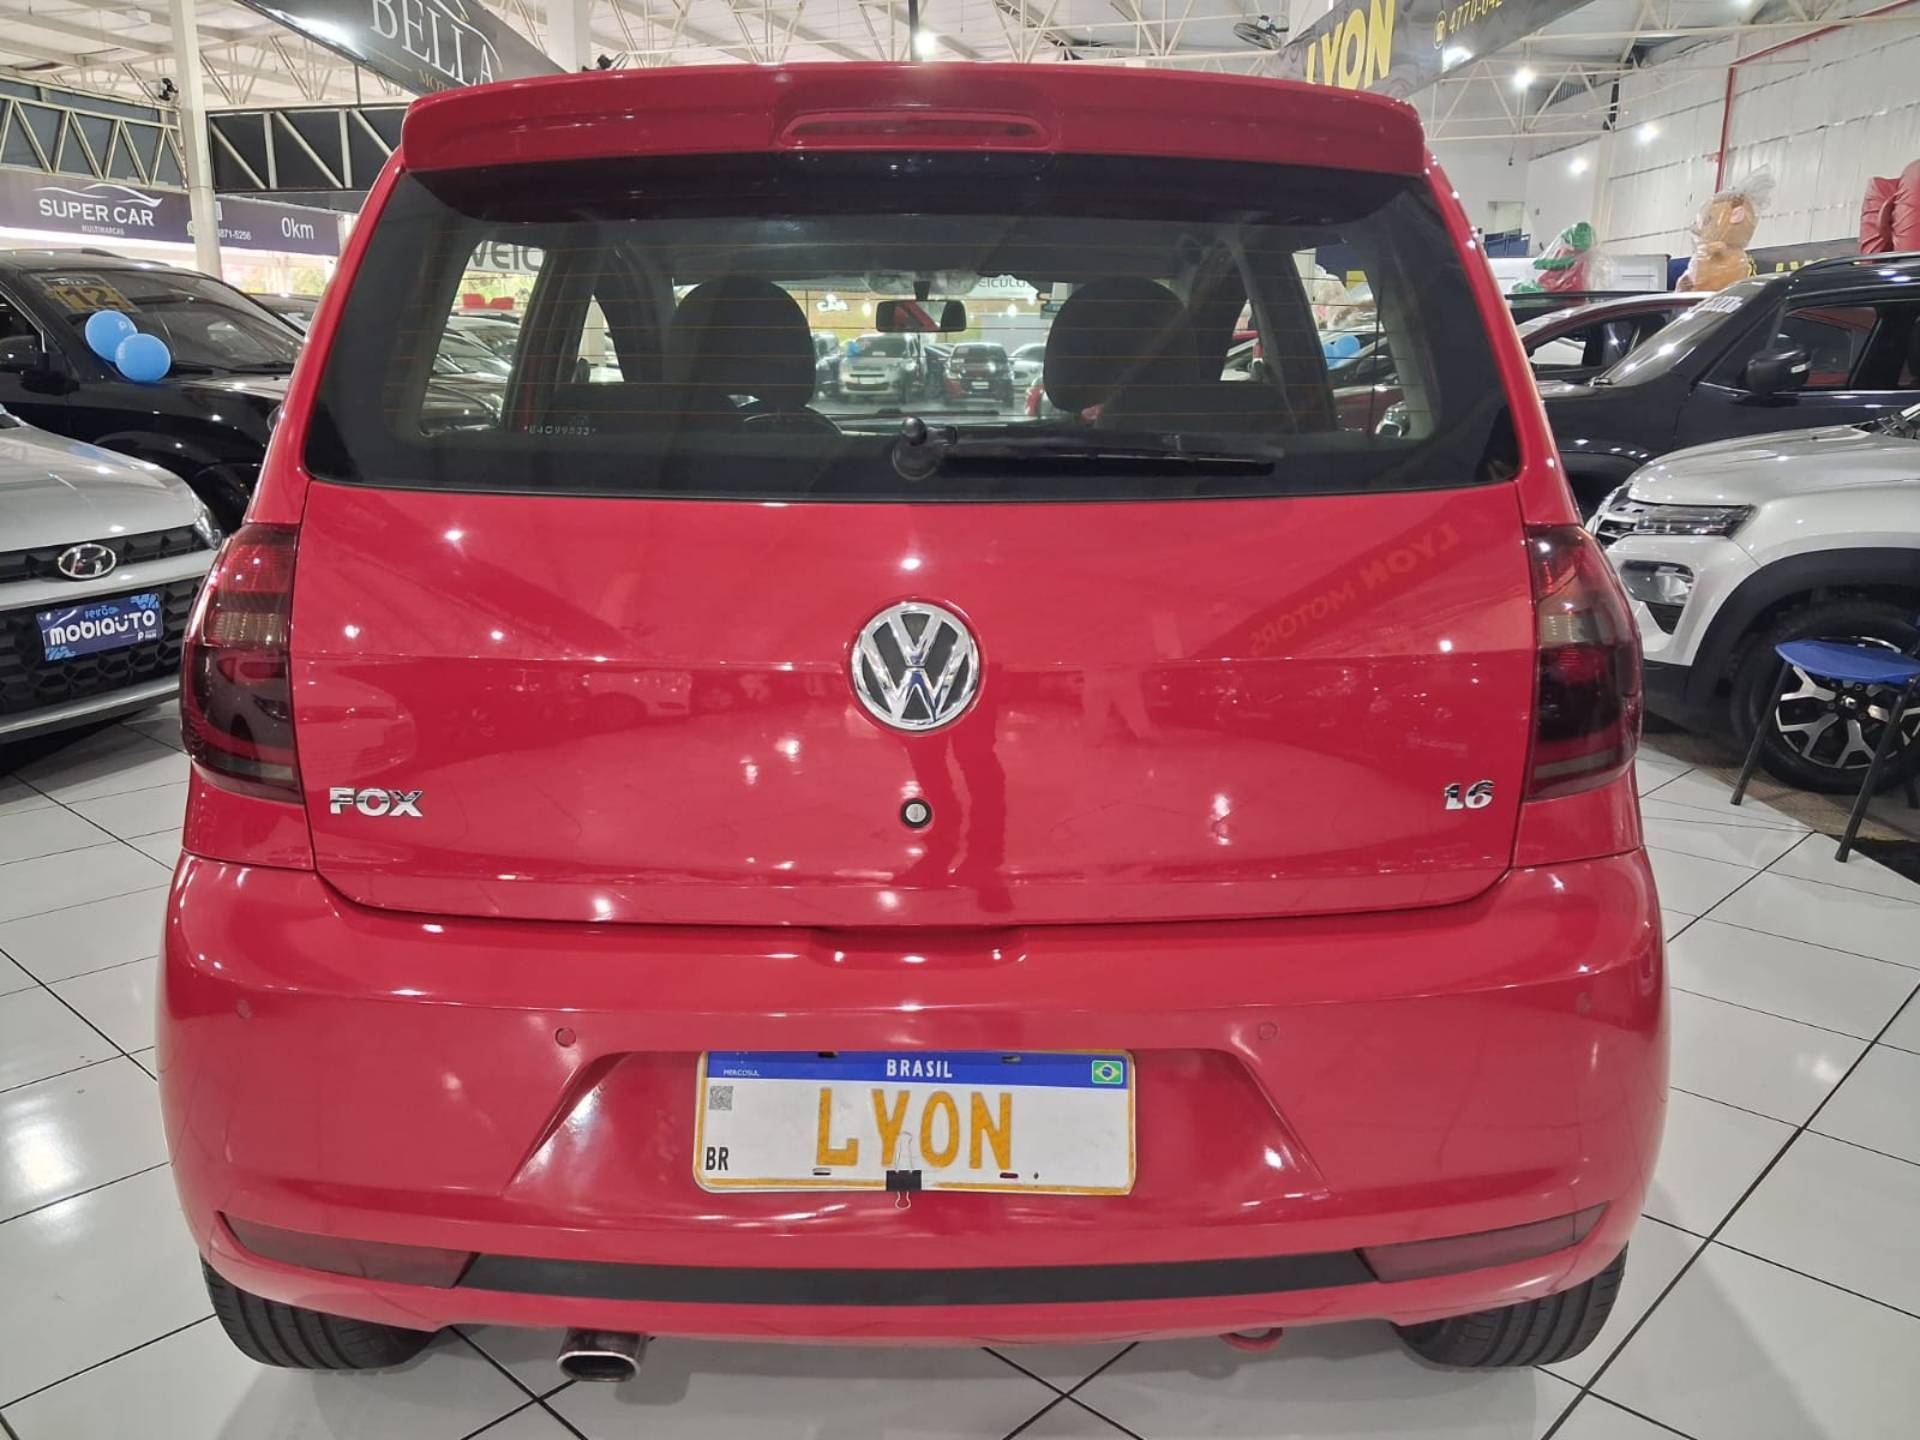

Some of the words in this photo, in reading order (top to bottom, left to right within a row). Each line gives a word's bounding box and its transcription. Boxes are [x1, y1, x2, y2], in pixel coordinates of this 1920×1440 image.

[370, 0, 493, 86] BELLA
[39, 198, 110, 222] SUPER
[113, 206, 155, 227] CAR
[329, 787, 423, 817] FOX
[886, 1059, 953, 1078] BRASIL
[816, 1087, 1013, 1169] LYON
[705, 1146, 729, 1170] BR
